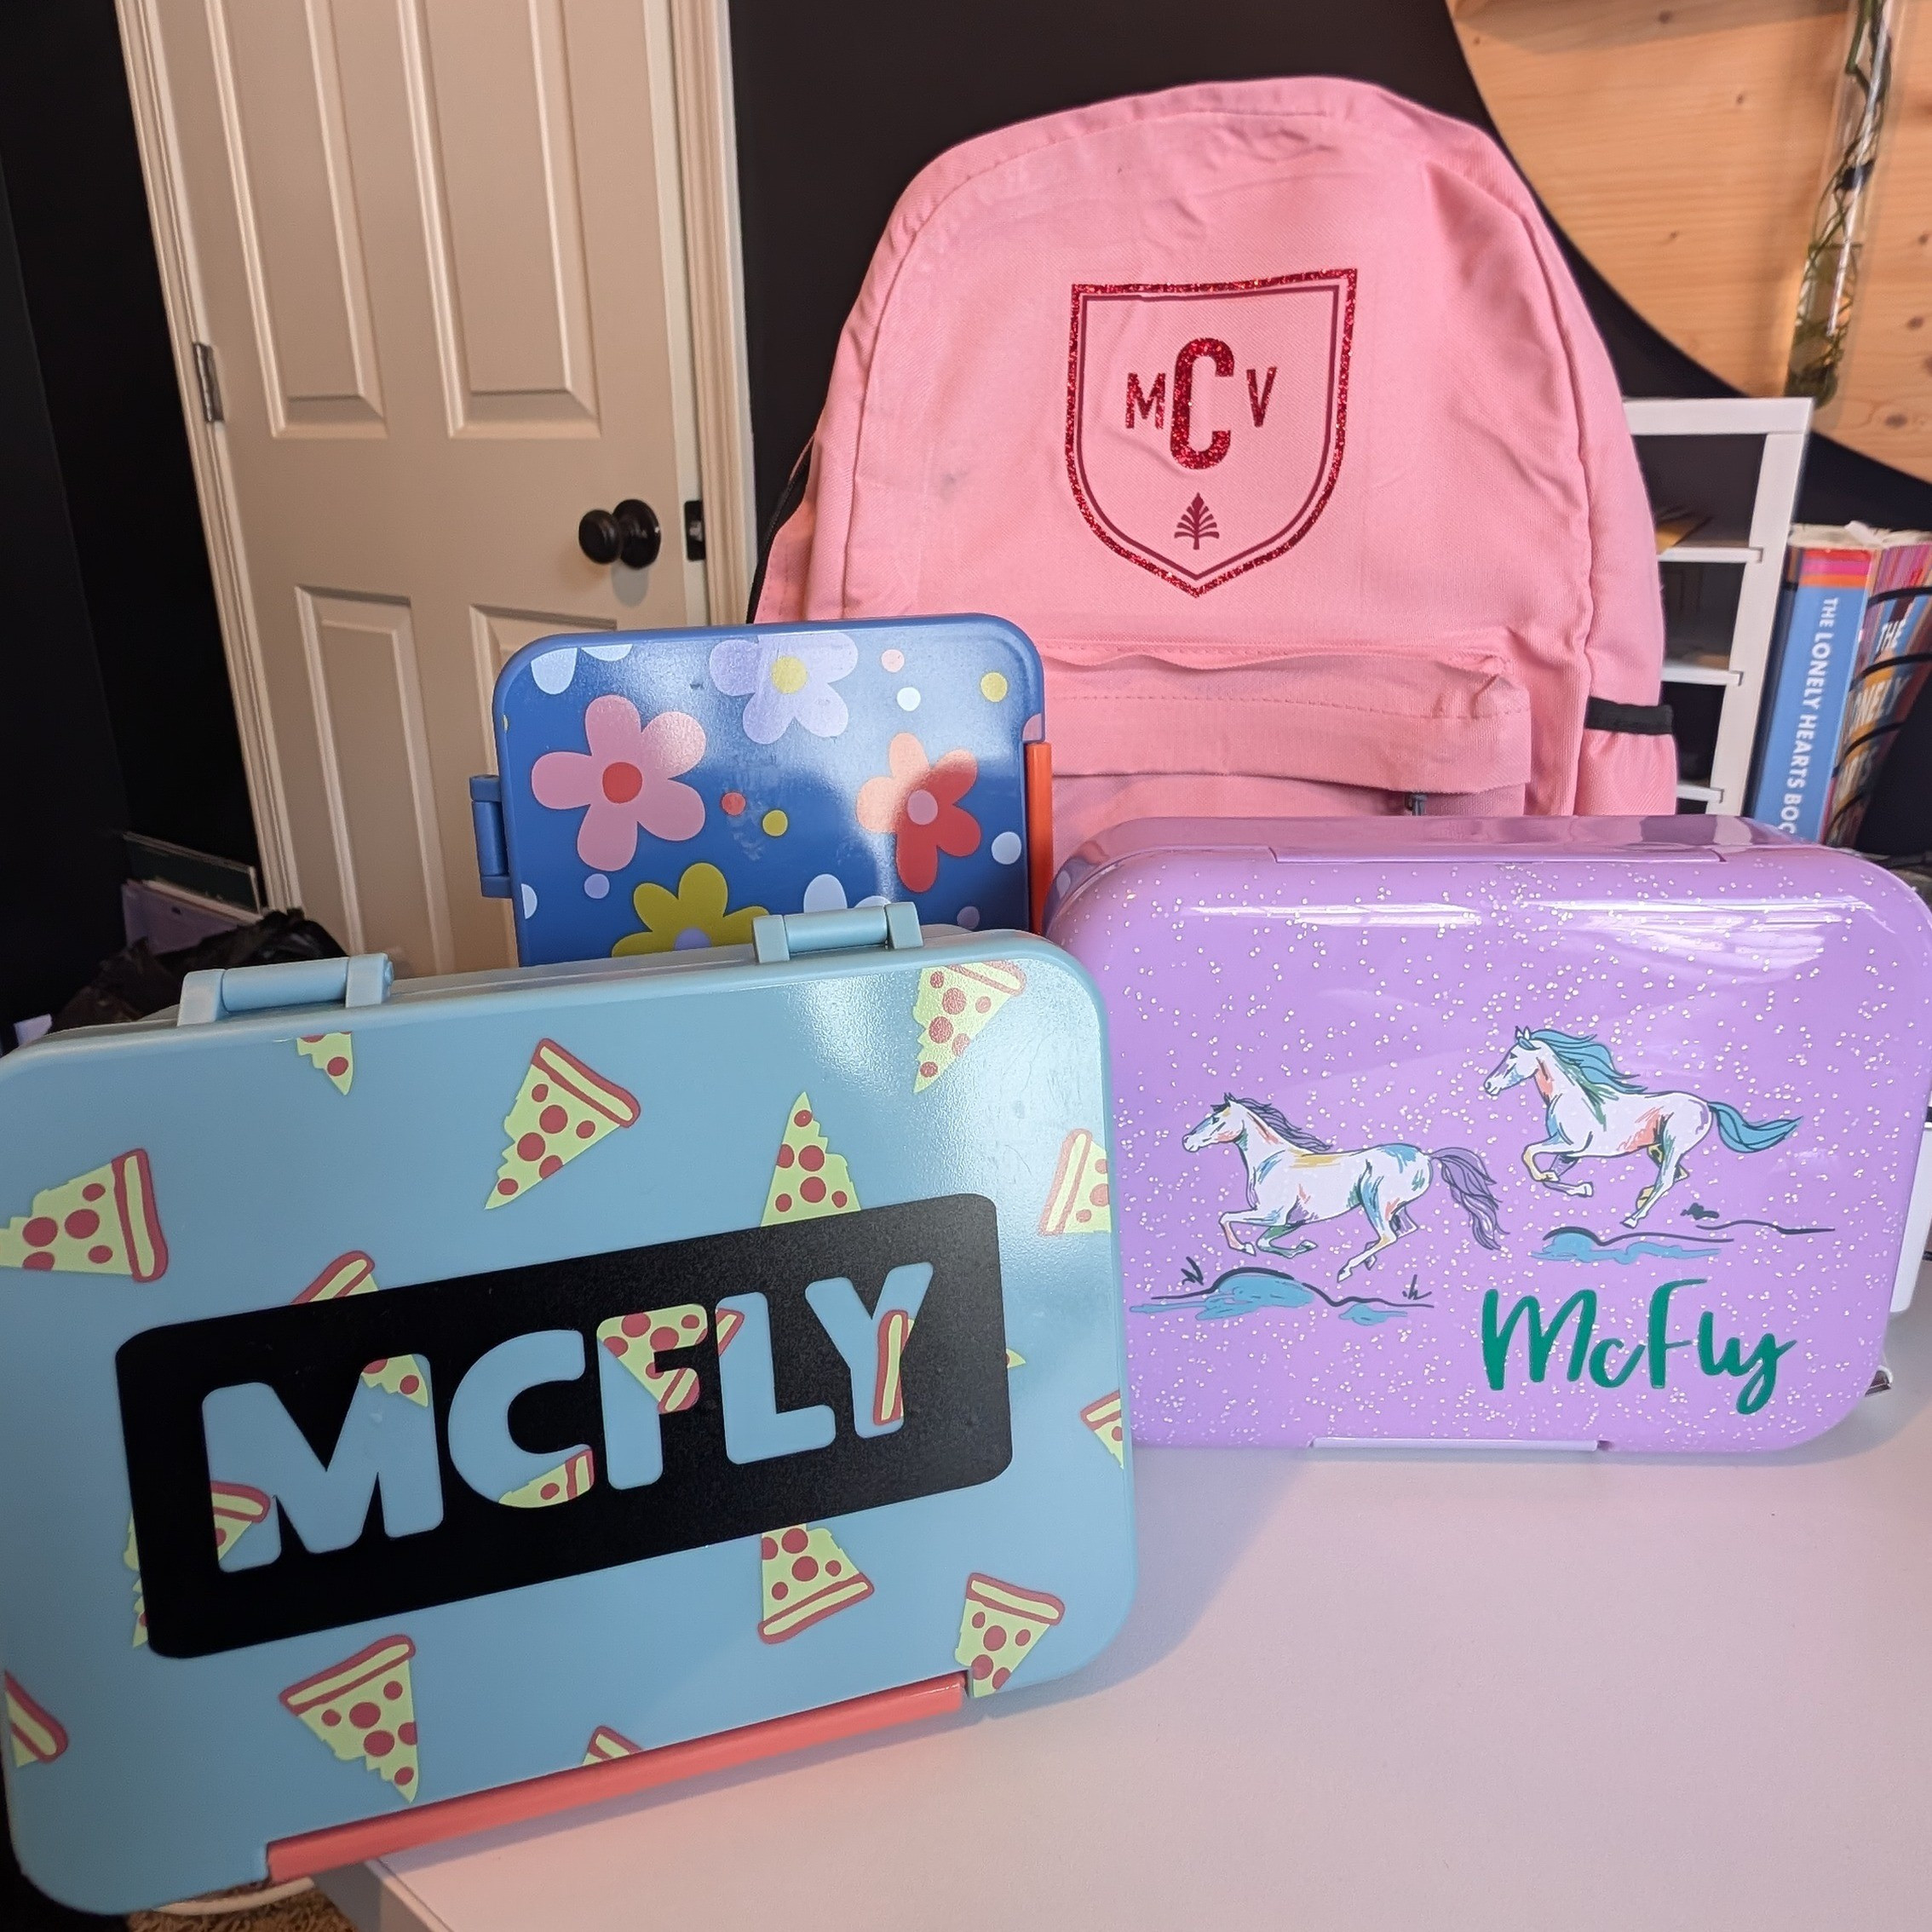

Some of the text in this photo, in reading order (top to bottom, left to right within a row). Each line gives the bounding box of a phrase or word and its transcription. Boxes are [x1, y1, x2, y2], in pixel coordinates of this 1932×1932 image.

[1819, 597, 1838, 627] THE
[1803, 632, 1834, 710] LONELY
[1786, 714, 1819, 789] HEARTS
[1481, 1279, 1797, 1415] McFly
[201, 1261, 934, 1573] MCFLY
